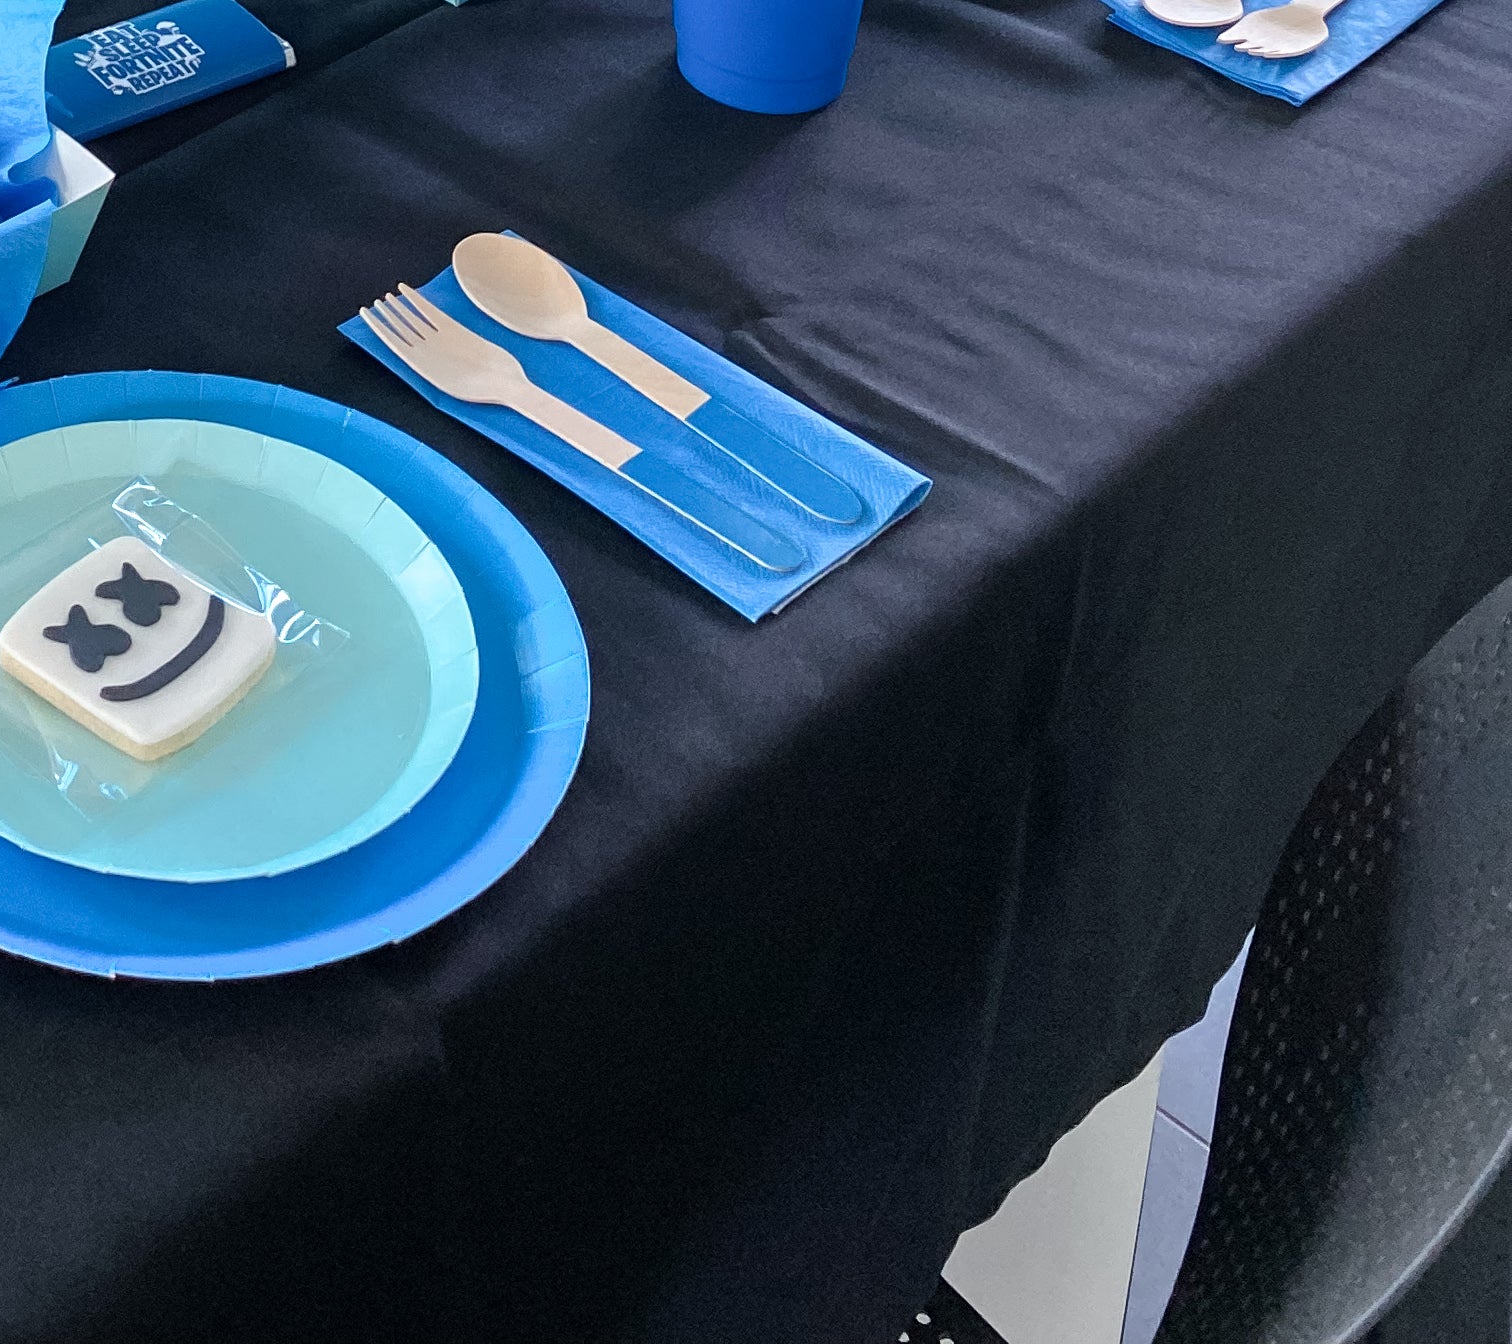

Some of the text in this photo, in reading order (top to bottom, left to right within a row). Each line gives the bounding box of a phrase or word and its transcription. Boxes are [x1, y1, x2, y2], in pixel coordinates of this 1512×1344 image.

[90, 23, 144, 48] EAT
[100, 33, 161, 63] SLEEP
[92, 38, 205, 85] FORTNITE
[128, 62, 193, 92] REPEAT
